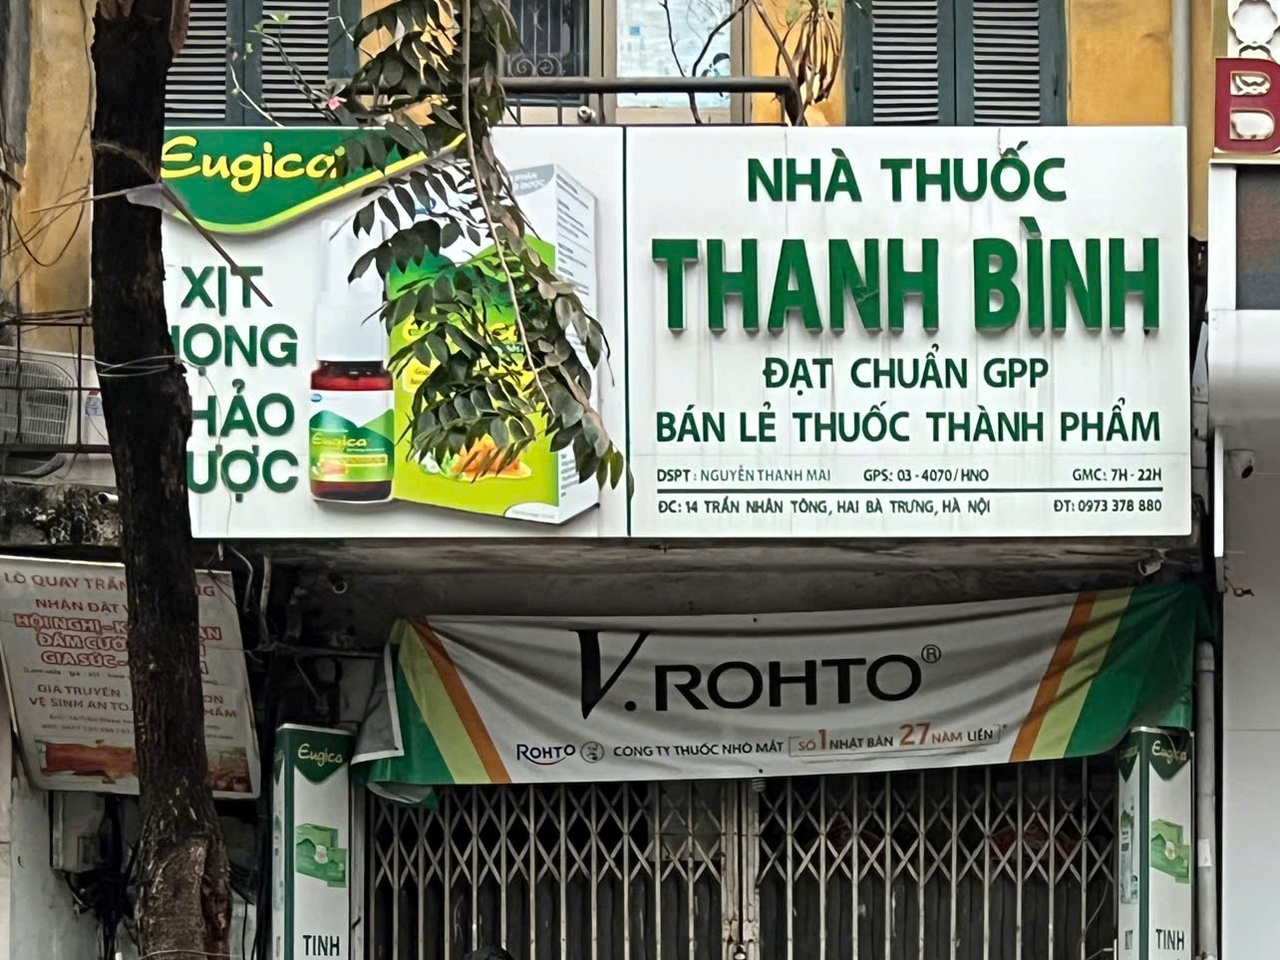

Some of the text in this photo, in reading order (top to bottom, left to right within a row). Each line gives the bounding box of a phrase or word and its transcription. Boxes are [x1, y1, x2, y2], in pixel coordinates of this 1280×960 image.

[160, 135, 338, 193] Eugica
[747, 141, 1067, 202] NHÀ THUỐC
[652, 217, 1160, 334] THANH BÌNH
[181, 266, 263, 316] XỊT
[762, 344, 1048, 396] ĐẠT CHUẨN GPP
[191, 379, 295, 437] HẢO
[656, 397, 1161, 443] BÁN LẺ THUỐC THÀNH PHẨM
[186, 444, 298, 502] ƯỢC
[757, 469, 803, 482] THANH
[806, 469, 831, 482] MAI
[863, 469, 894, 482] GPS:
[1072, 468, 1107, 481] GMC:
[658, 500, 682, 514] ĐC:
[837, 500, 859, 514] HAI
[866, 498, 883, 514] BÀ
[942, 497, 961, 513] HÀ
[968, 497, 990, 515] NỘI
[1078, 499, 1108, 513] 0973
[1112, 499, 1134, 513] 378
[1138, 499, 1162, 512] 880
[31, 575, 79, 588] QUAY
[899, 722, 930, 746] 27
[517, 744, 576, 763] ROHTO
[656, 746, 670, 756] TY
[303, 935, 340, 957] TINH
[1155, 929, 1185, 950] TINH
